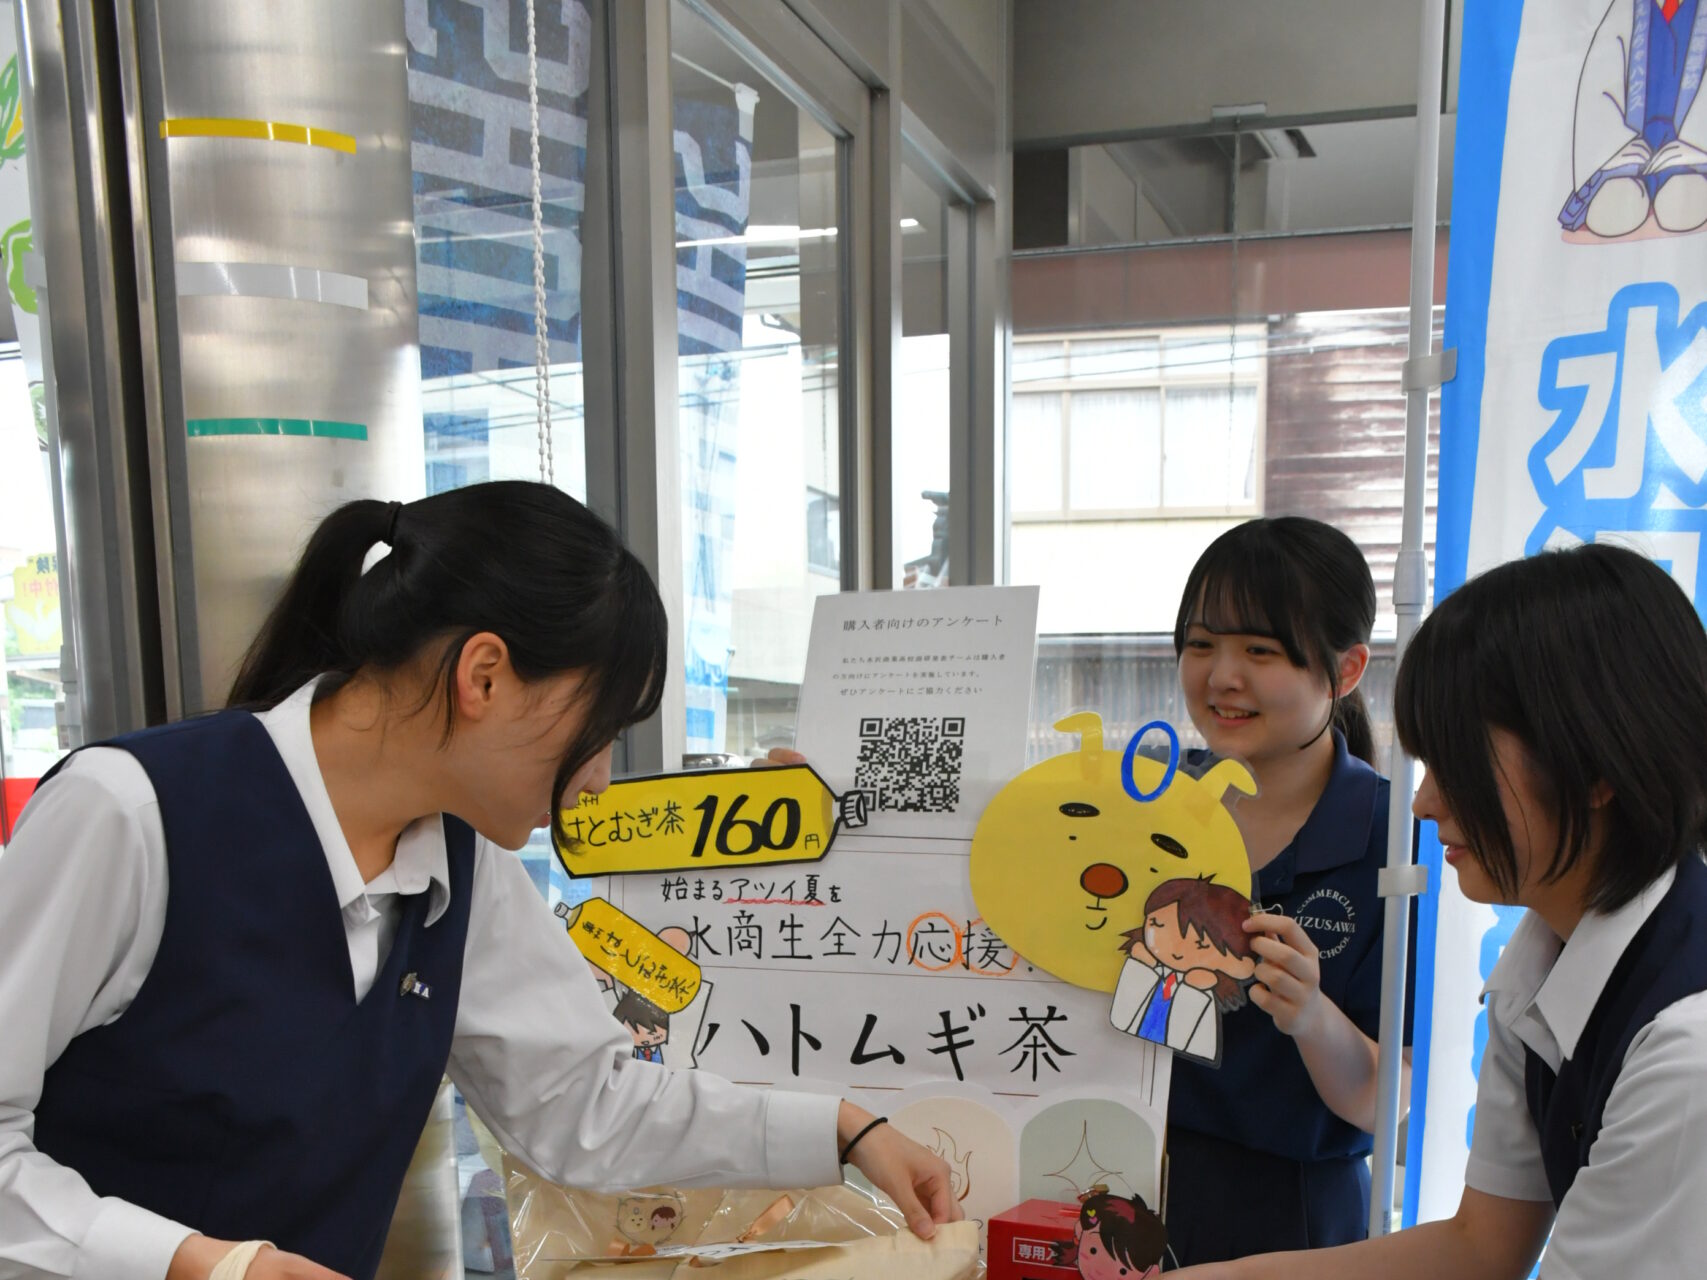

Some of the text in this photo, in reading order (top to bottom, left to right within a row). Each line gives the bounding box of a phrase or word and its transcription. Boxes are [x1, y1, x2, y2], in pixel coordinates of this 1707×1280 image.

[842, 614, 1004, 632] 購入者向けのアンケート
[660, 873, 842, 904] 始まるアツイ夏を
[689, 909, 1035, 974] 水商生全力応援
[1318, 935, 1351, 960] CHOOL
[698, 1003, 1078, 1082] ハトムギ茶
